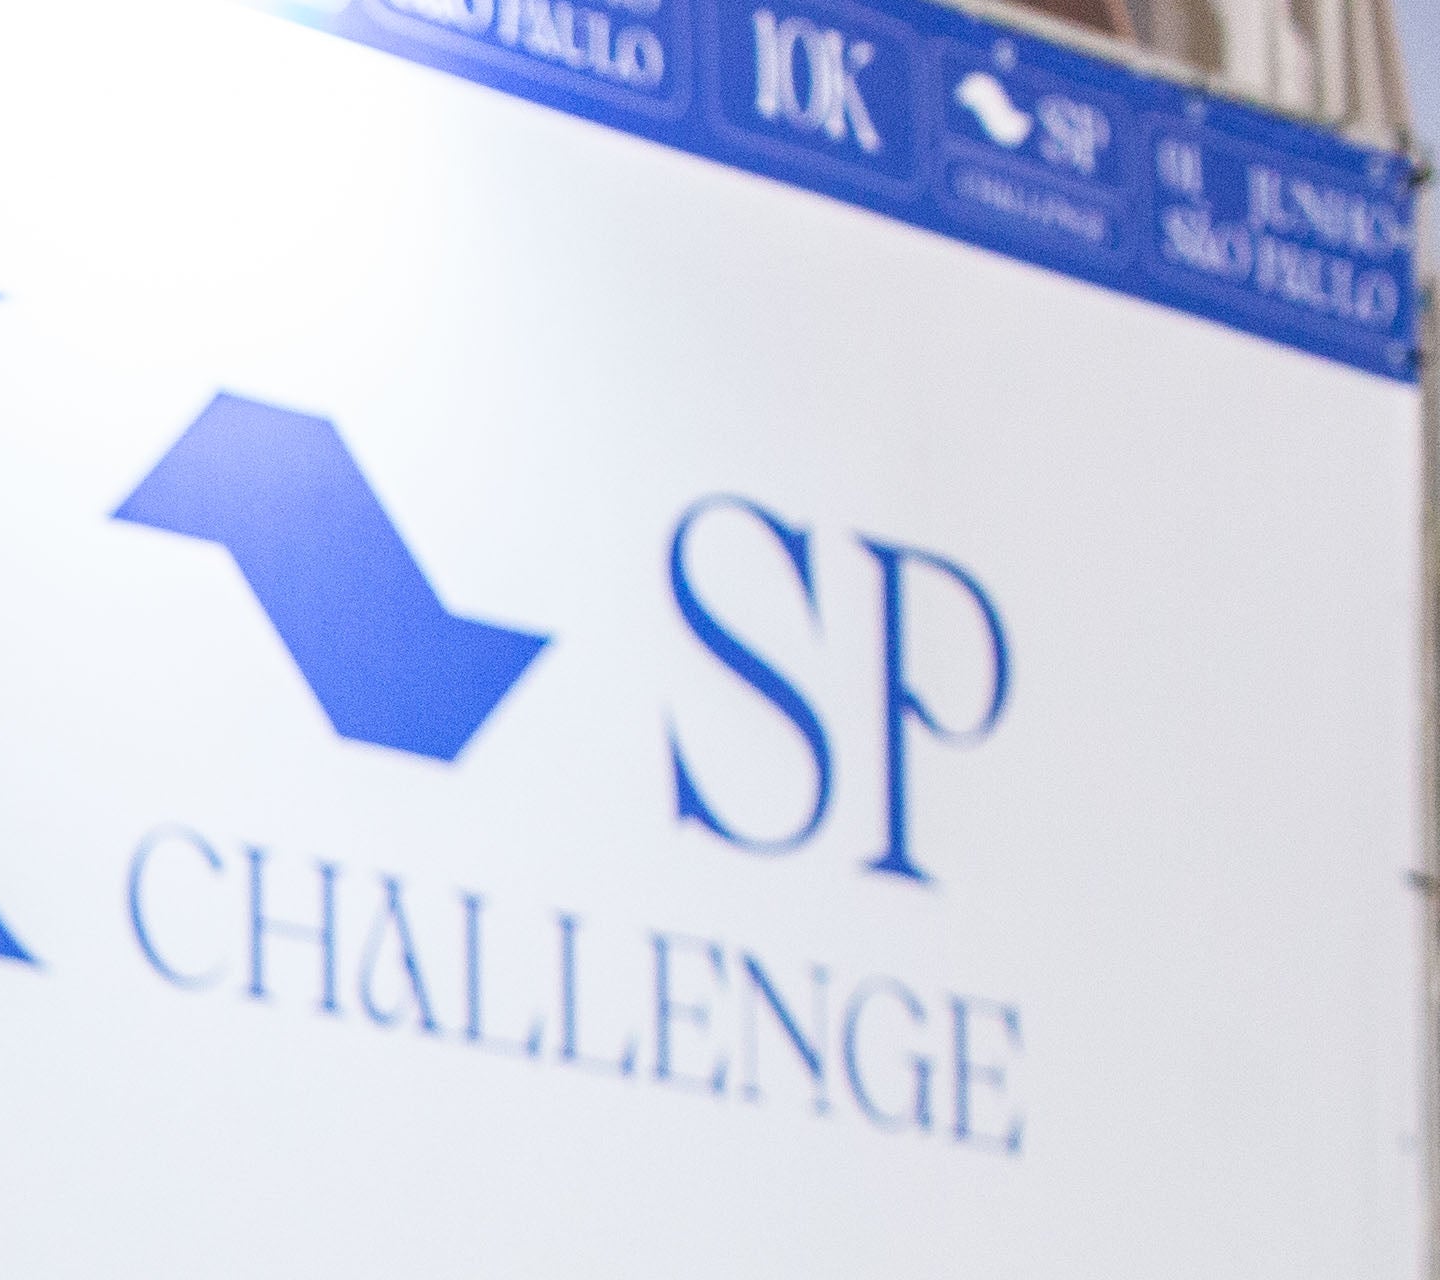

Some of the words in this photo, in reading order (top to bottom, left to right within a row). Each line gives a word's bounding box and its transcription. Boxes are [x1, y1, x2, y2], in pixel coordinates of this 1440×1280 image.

[753, 8, 880, 153] 10K
[662, 493, 1010, 892] SP
[126, 823, 1028, 1160] CHALLENGE
